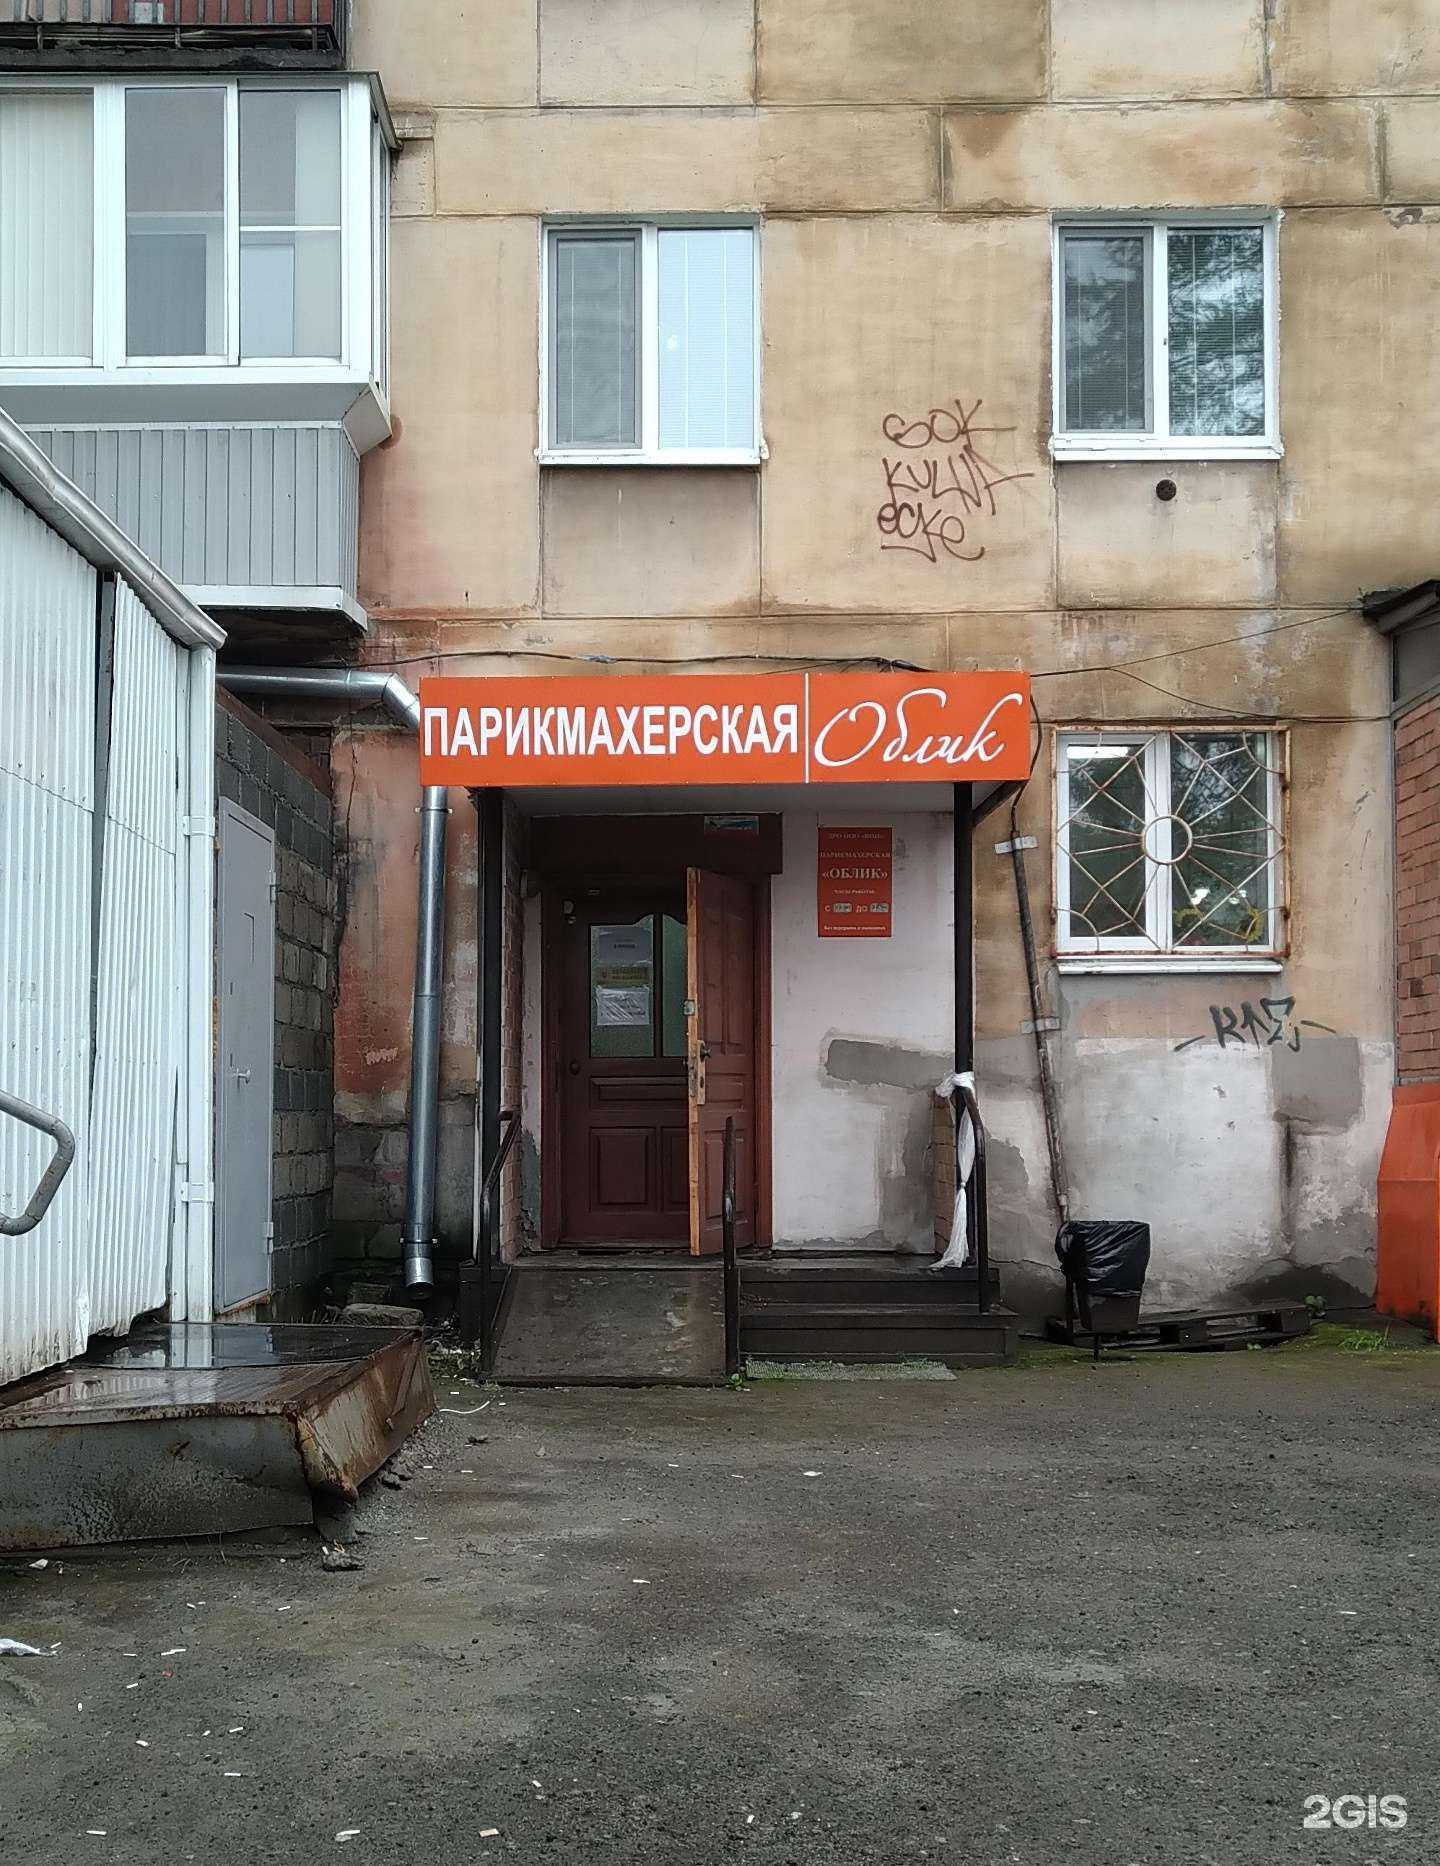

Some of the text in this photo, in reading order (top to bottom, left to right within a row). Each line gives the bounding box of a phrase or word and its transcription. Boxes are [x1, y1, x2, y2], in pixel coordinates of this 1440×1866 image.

[423, 687, 1023, 767] ПАРИКМАХЕРСКАЯ Облик
[822, 867, 888, 880] «ОБЛИК»
